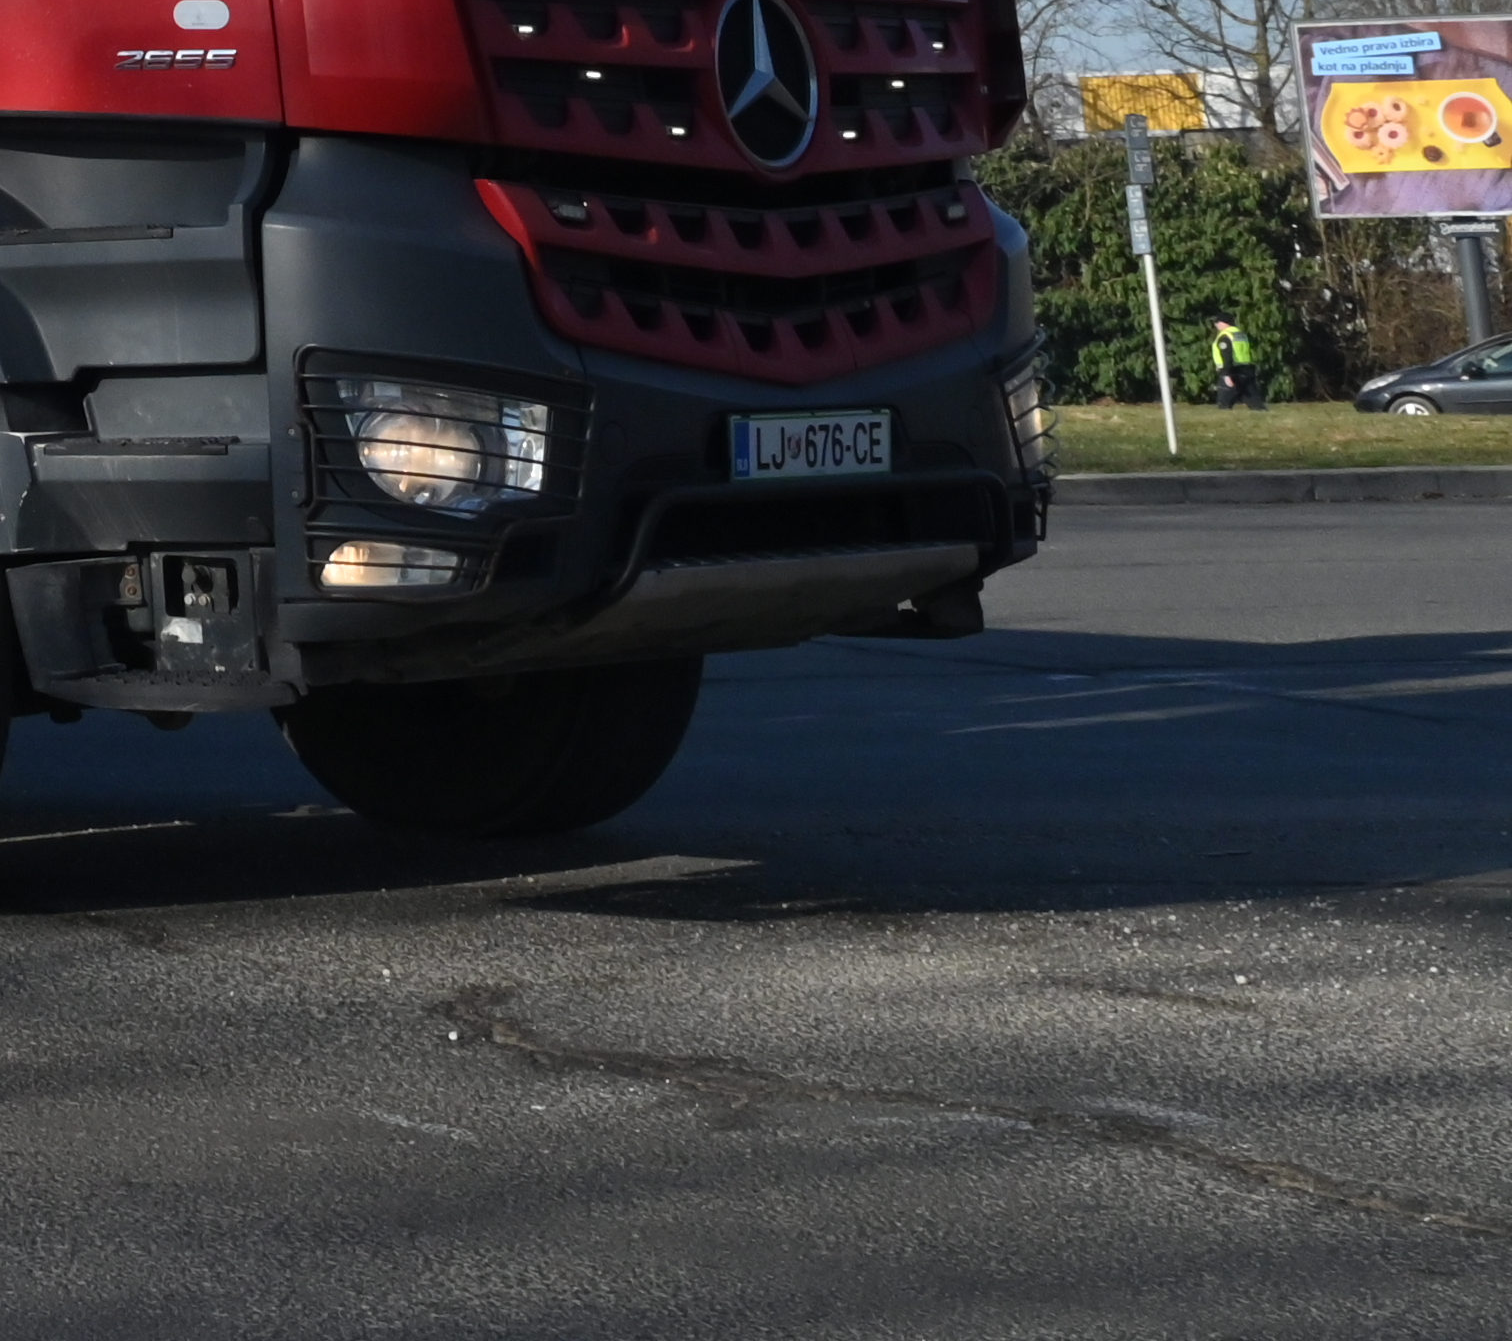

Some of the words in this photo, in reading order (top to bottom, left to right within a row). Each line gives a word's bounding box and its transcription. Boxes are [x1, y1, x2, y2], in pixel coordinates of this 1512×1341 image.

[1319, 45, 1359, 56] Vedno
[1362, 40, 1398, 55] prava
[1400, 36, 1434, 48] izbira
[114, 49, 238, 70] 2655
[1317, 61, 1338, 71] kot
[1341, 63, 1357, 71] na
[1360, 60, 1408, 73] pladnju
[805, 421, 883, 468] 676-CE
